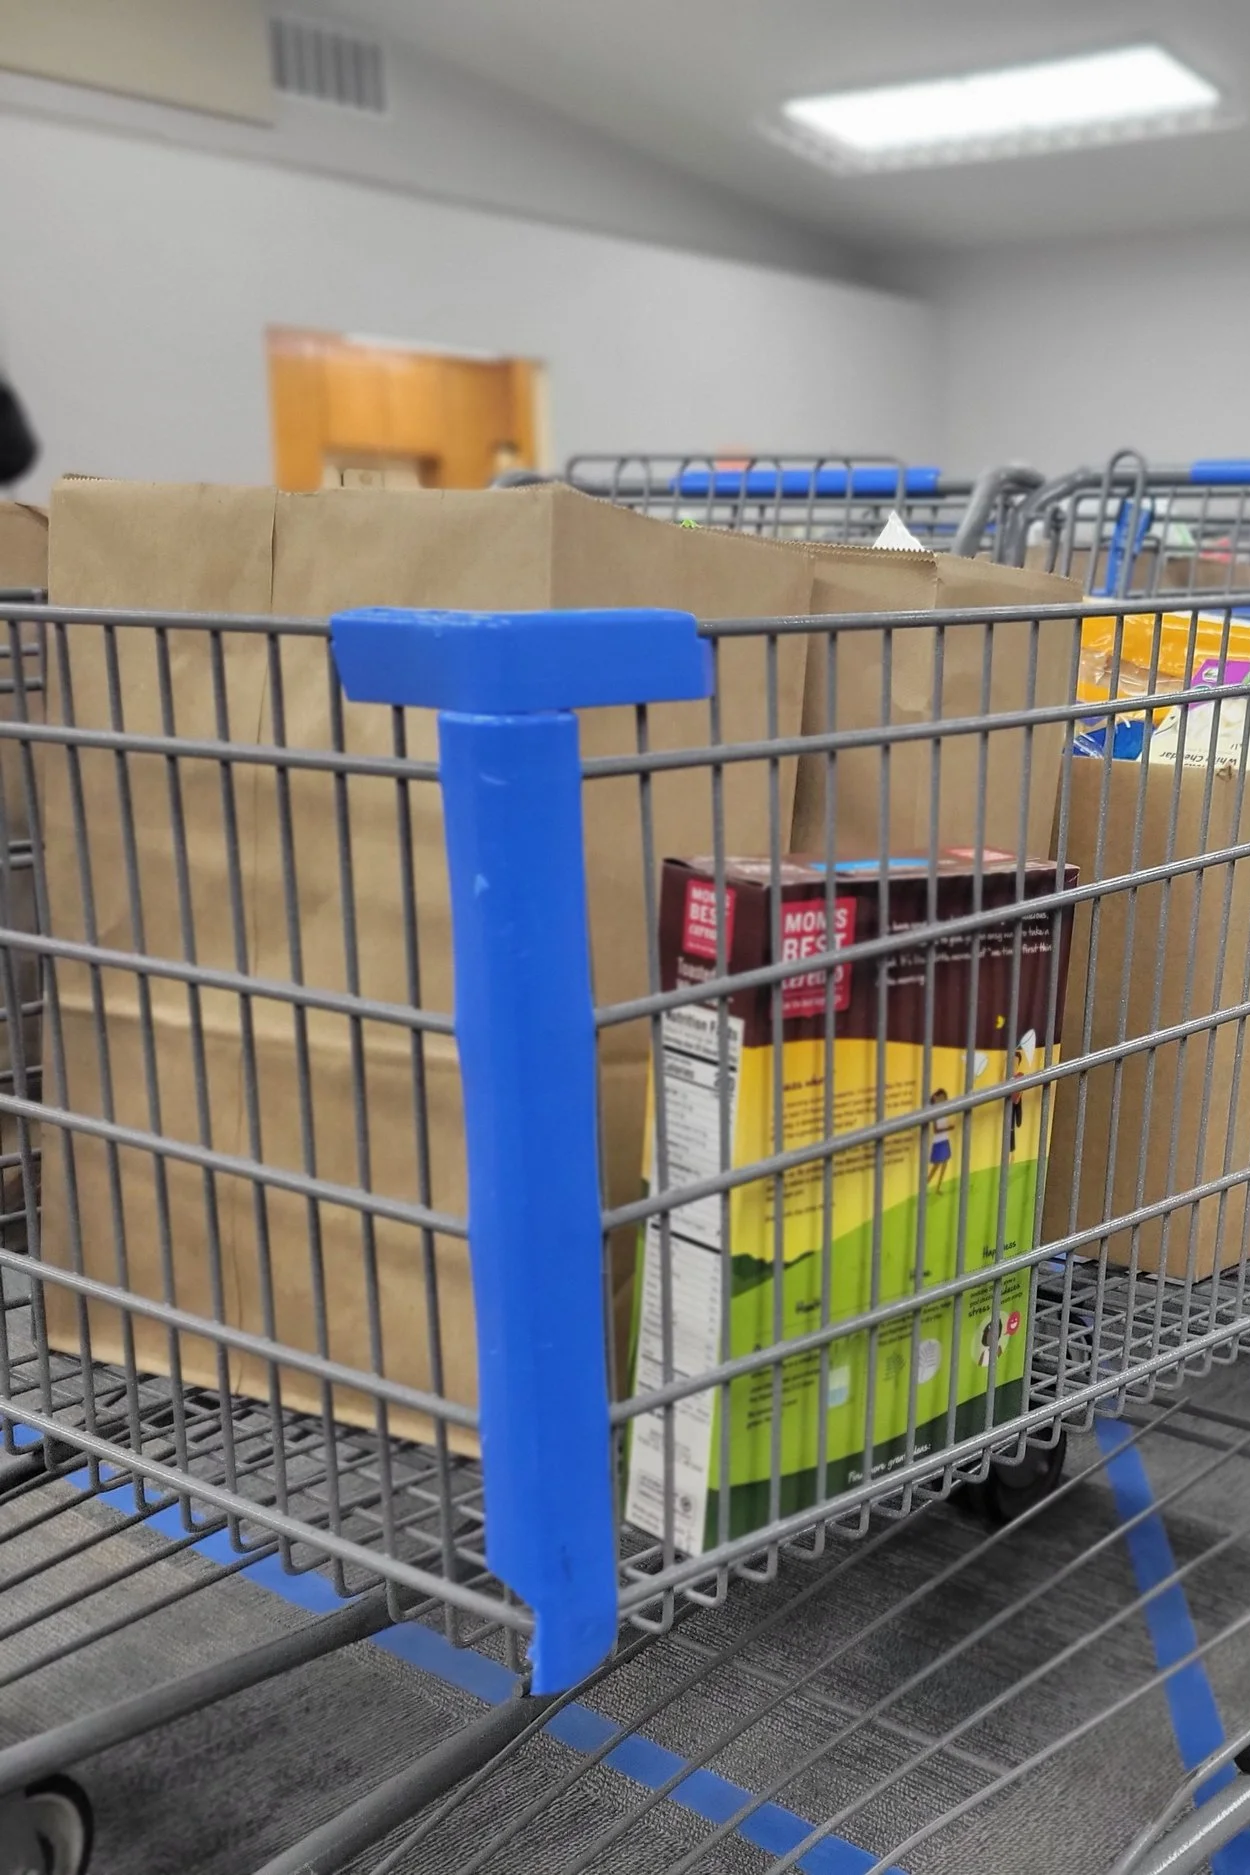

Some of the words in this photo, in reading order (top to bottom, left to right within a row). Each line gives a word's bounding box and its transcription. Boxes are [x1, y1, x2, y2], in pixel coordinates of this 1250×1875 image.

[1158, 750, 1204, 763] Chedar
[691, 887, 731, 910] MOMS
[689, 902, 730, 926] BES
[784, 908, 849, 934] MOMS
